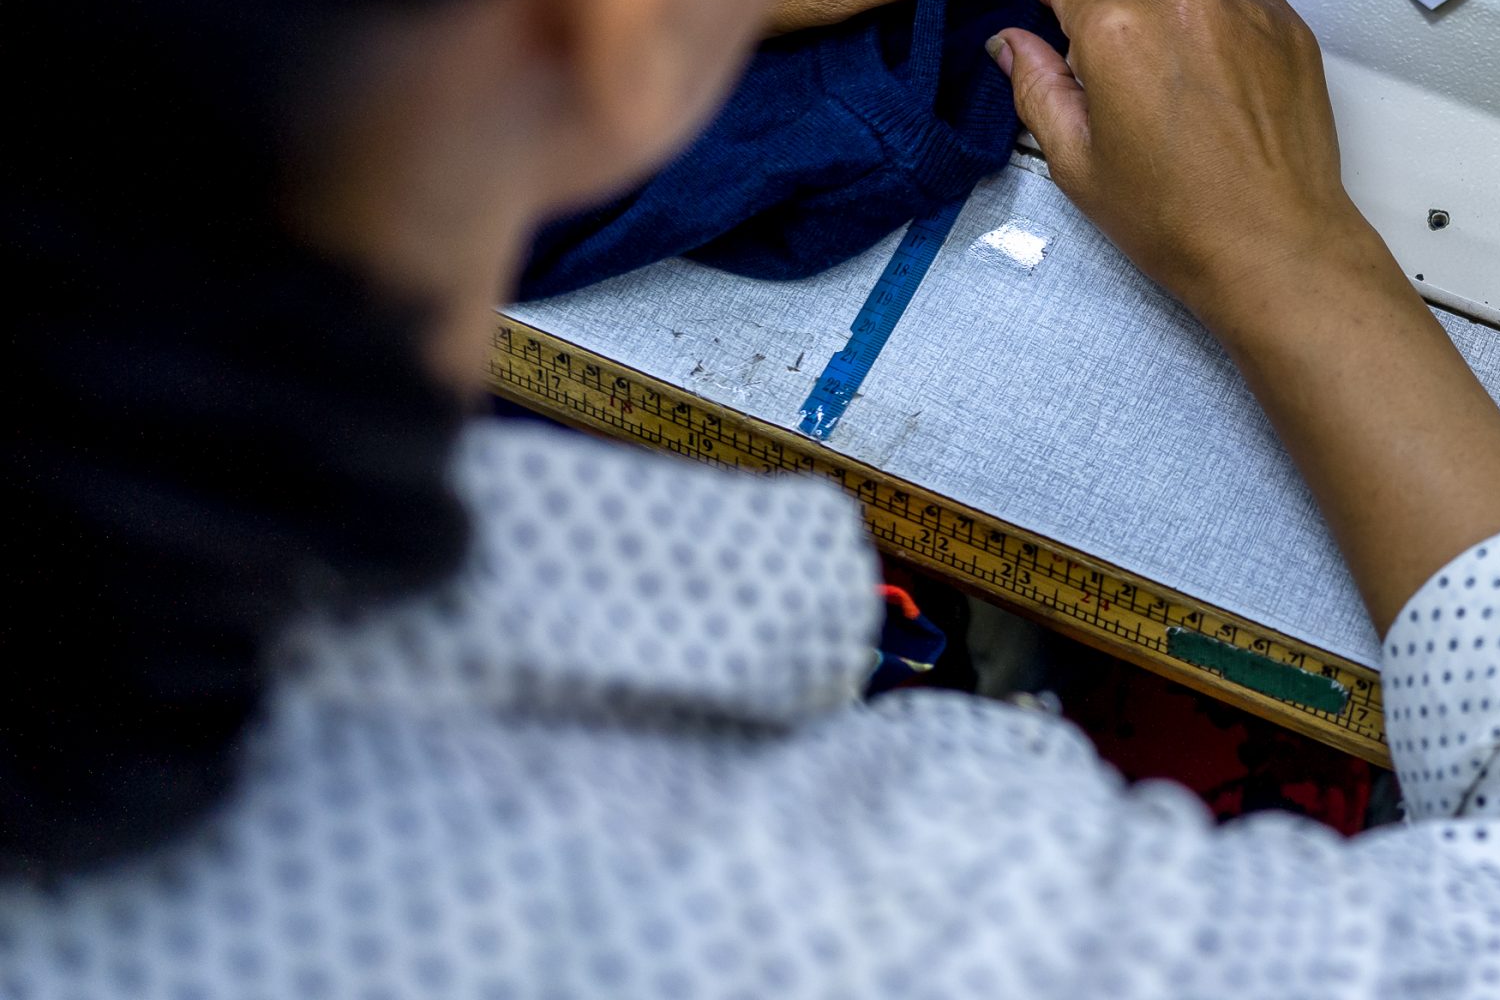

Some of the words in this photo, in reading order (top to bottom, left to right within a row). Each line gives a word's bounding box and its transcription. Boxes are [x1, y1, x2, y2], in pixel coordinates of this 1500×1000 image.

[892, 262, 910, 277] 18
[858, 319, 876, 335] 20
[822, 377, 841, 394] 22
[920, 529, 949, 551] 22
[1002, 563, 1031, 585] 23
